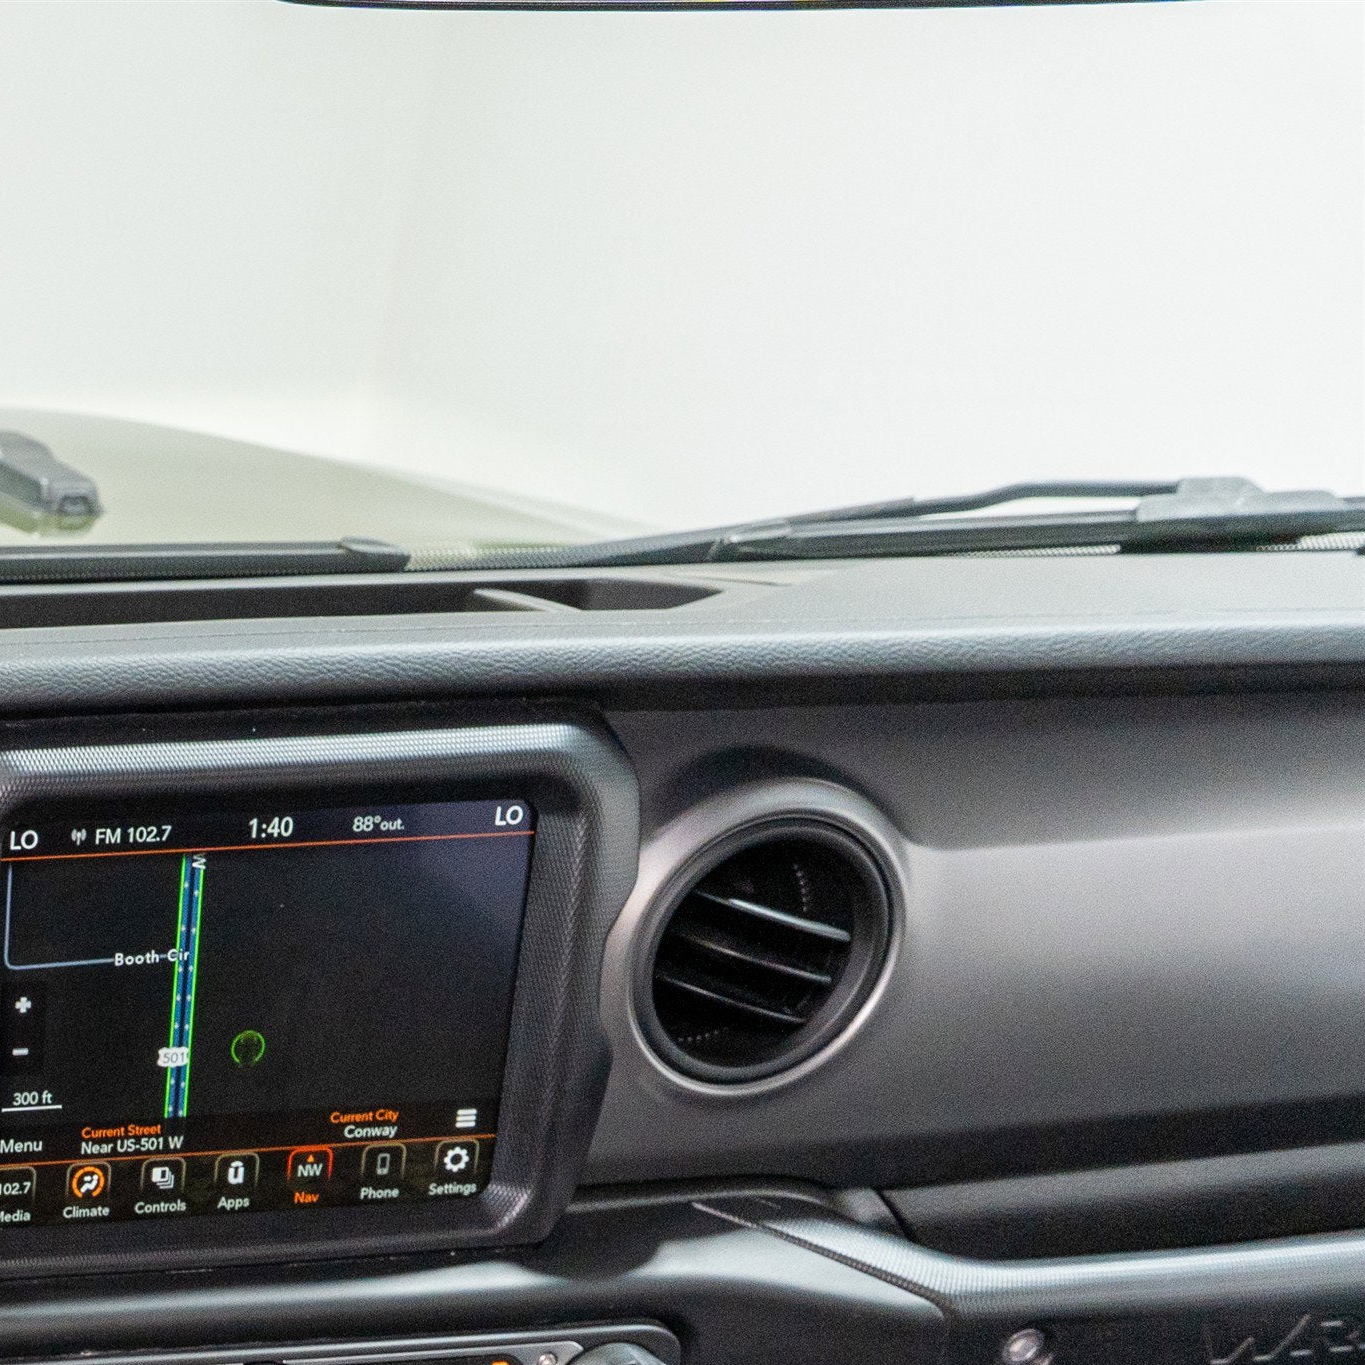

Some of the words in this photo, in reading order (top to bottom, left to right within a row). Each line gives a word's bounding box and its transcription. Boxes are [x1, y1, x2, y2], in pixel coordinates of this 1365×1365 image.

[494, 805, 524, 827] LO
[94, 827, 121, 845] FM
[127, 824, 172, 843] 102.7
[248, 816, 294, 838] 1:40
[9, 829, 39, 851] LO
[114, 949, 160, 966] Booth
[162, 1051, 186, 1065] 501
[13, 1091, 39, 1106] 300
[41, 1089, 53, 1104] ft
[330, 1111, 372, 1124] Current
[375, 1108, 399, 1123] City
[81, 1126, 132, 1140] Current
[134, 1124, 162, 1137] Street
[343, 1124, 398, 1140] Conway
[0, 1137, 43, 1155] Menu
[81, 1139, 113, 1155] Near
[116, 1135, 165, 1153] US-501
[168, 1135, 184, 1150] W
[297, 1161, 323, 1177] NW
[294, 1190, 319, 1204] Nav
[360, 1185, 400, 1201] Phone
[428, 1180, 477, 1197] Settings
[63, 1203, 110, 1219] Climate
[135, 1198, 187, 1214] Controls
[218, 1194, 250, 1211] Apps
